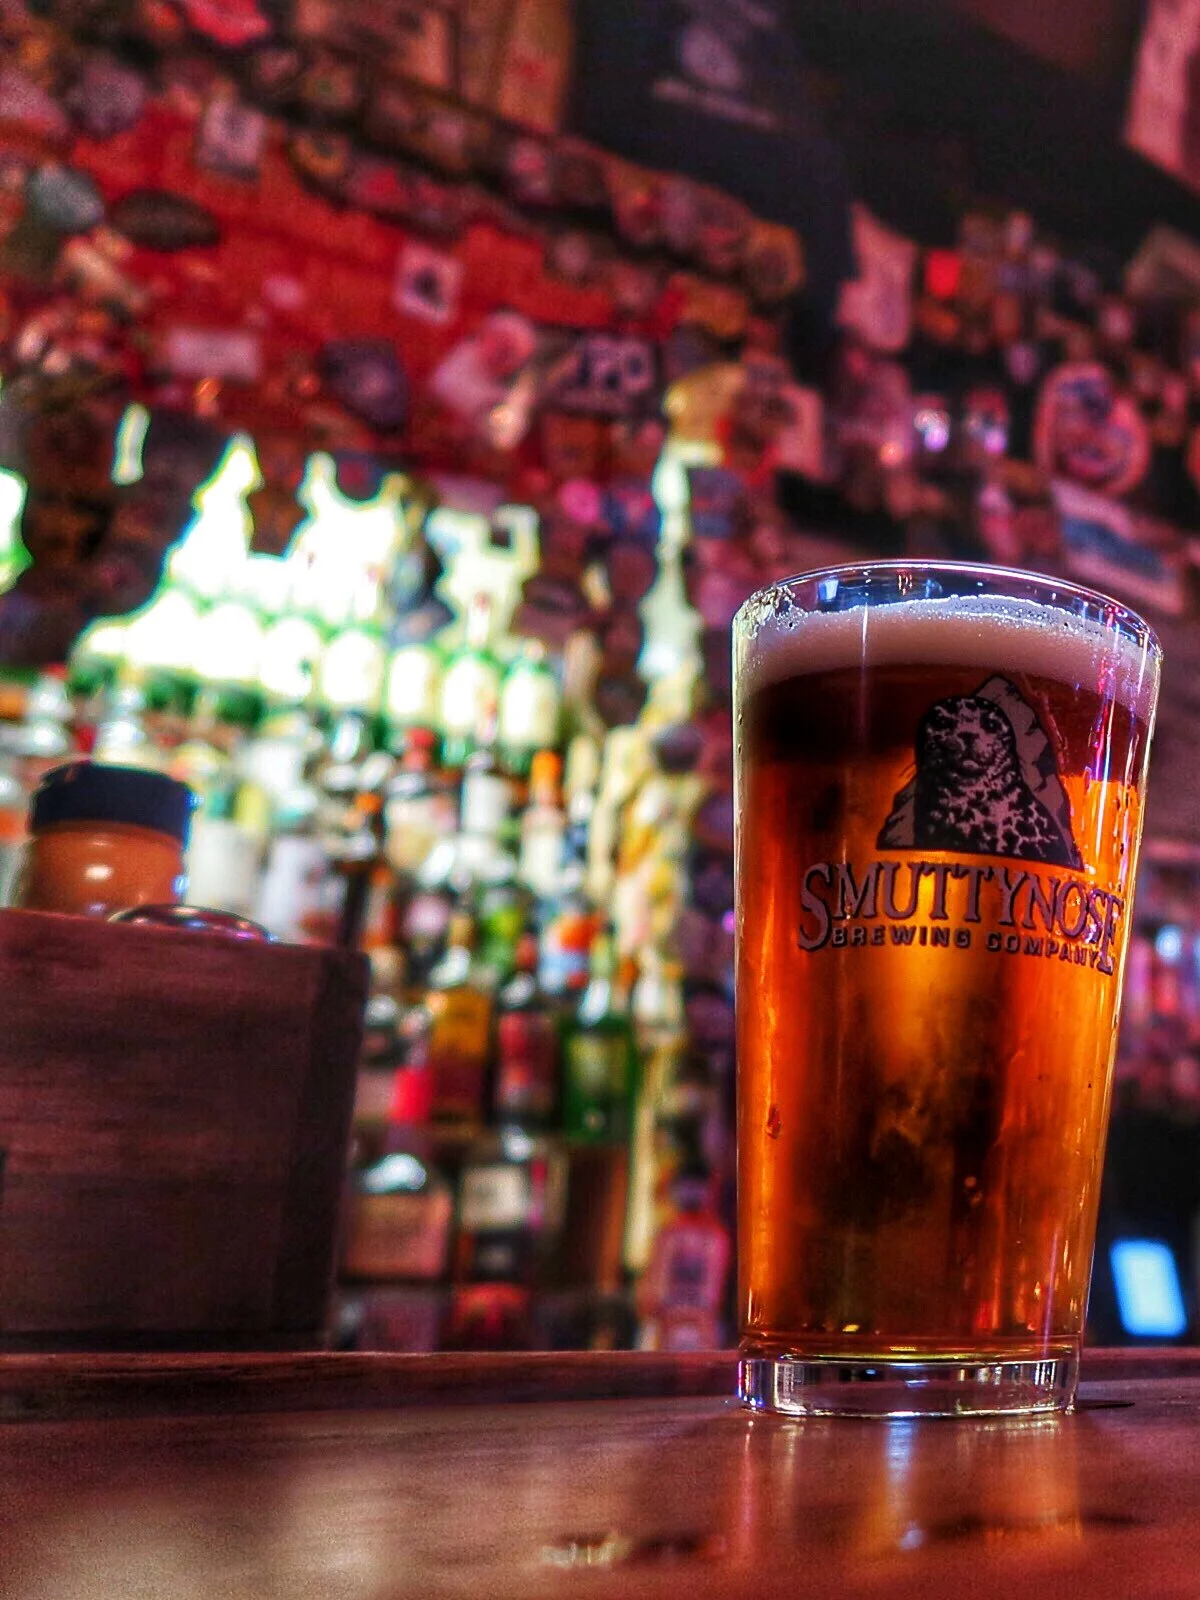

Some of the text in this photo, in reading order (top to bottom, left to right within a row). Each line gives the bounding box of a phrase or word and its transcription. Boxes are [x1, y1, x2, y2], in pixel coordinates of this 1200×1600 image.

[798, 862, 1123, 975] SMUTTYNOSE
[831, 925, 1100, 969] BREWING COMPANY
